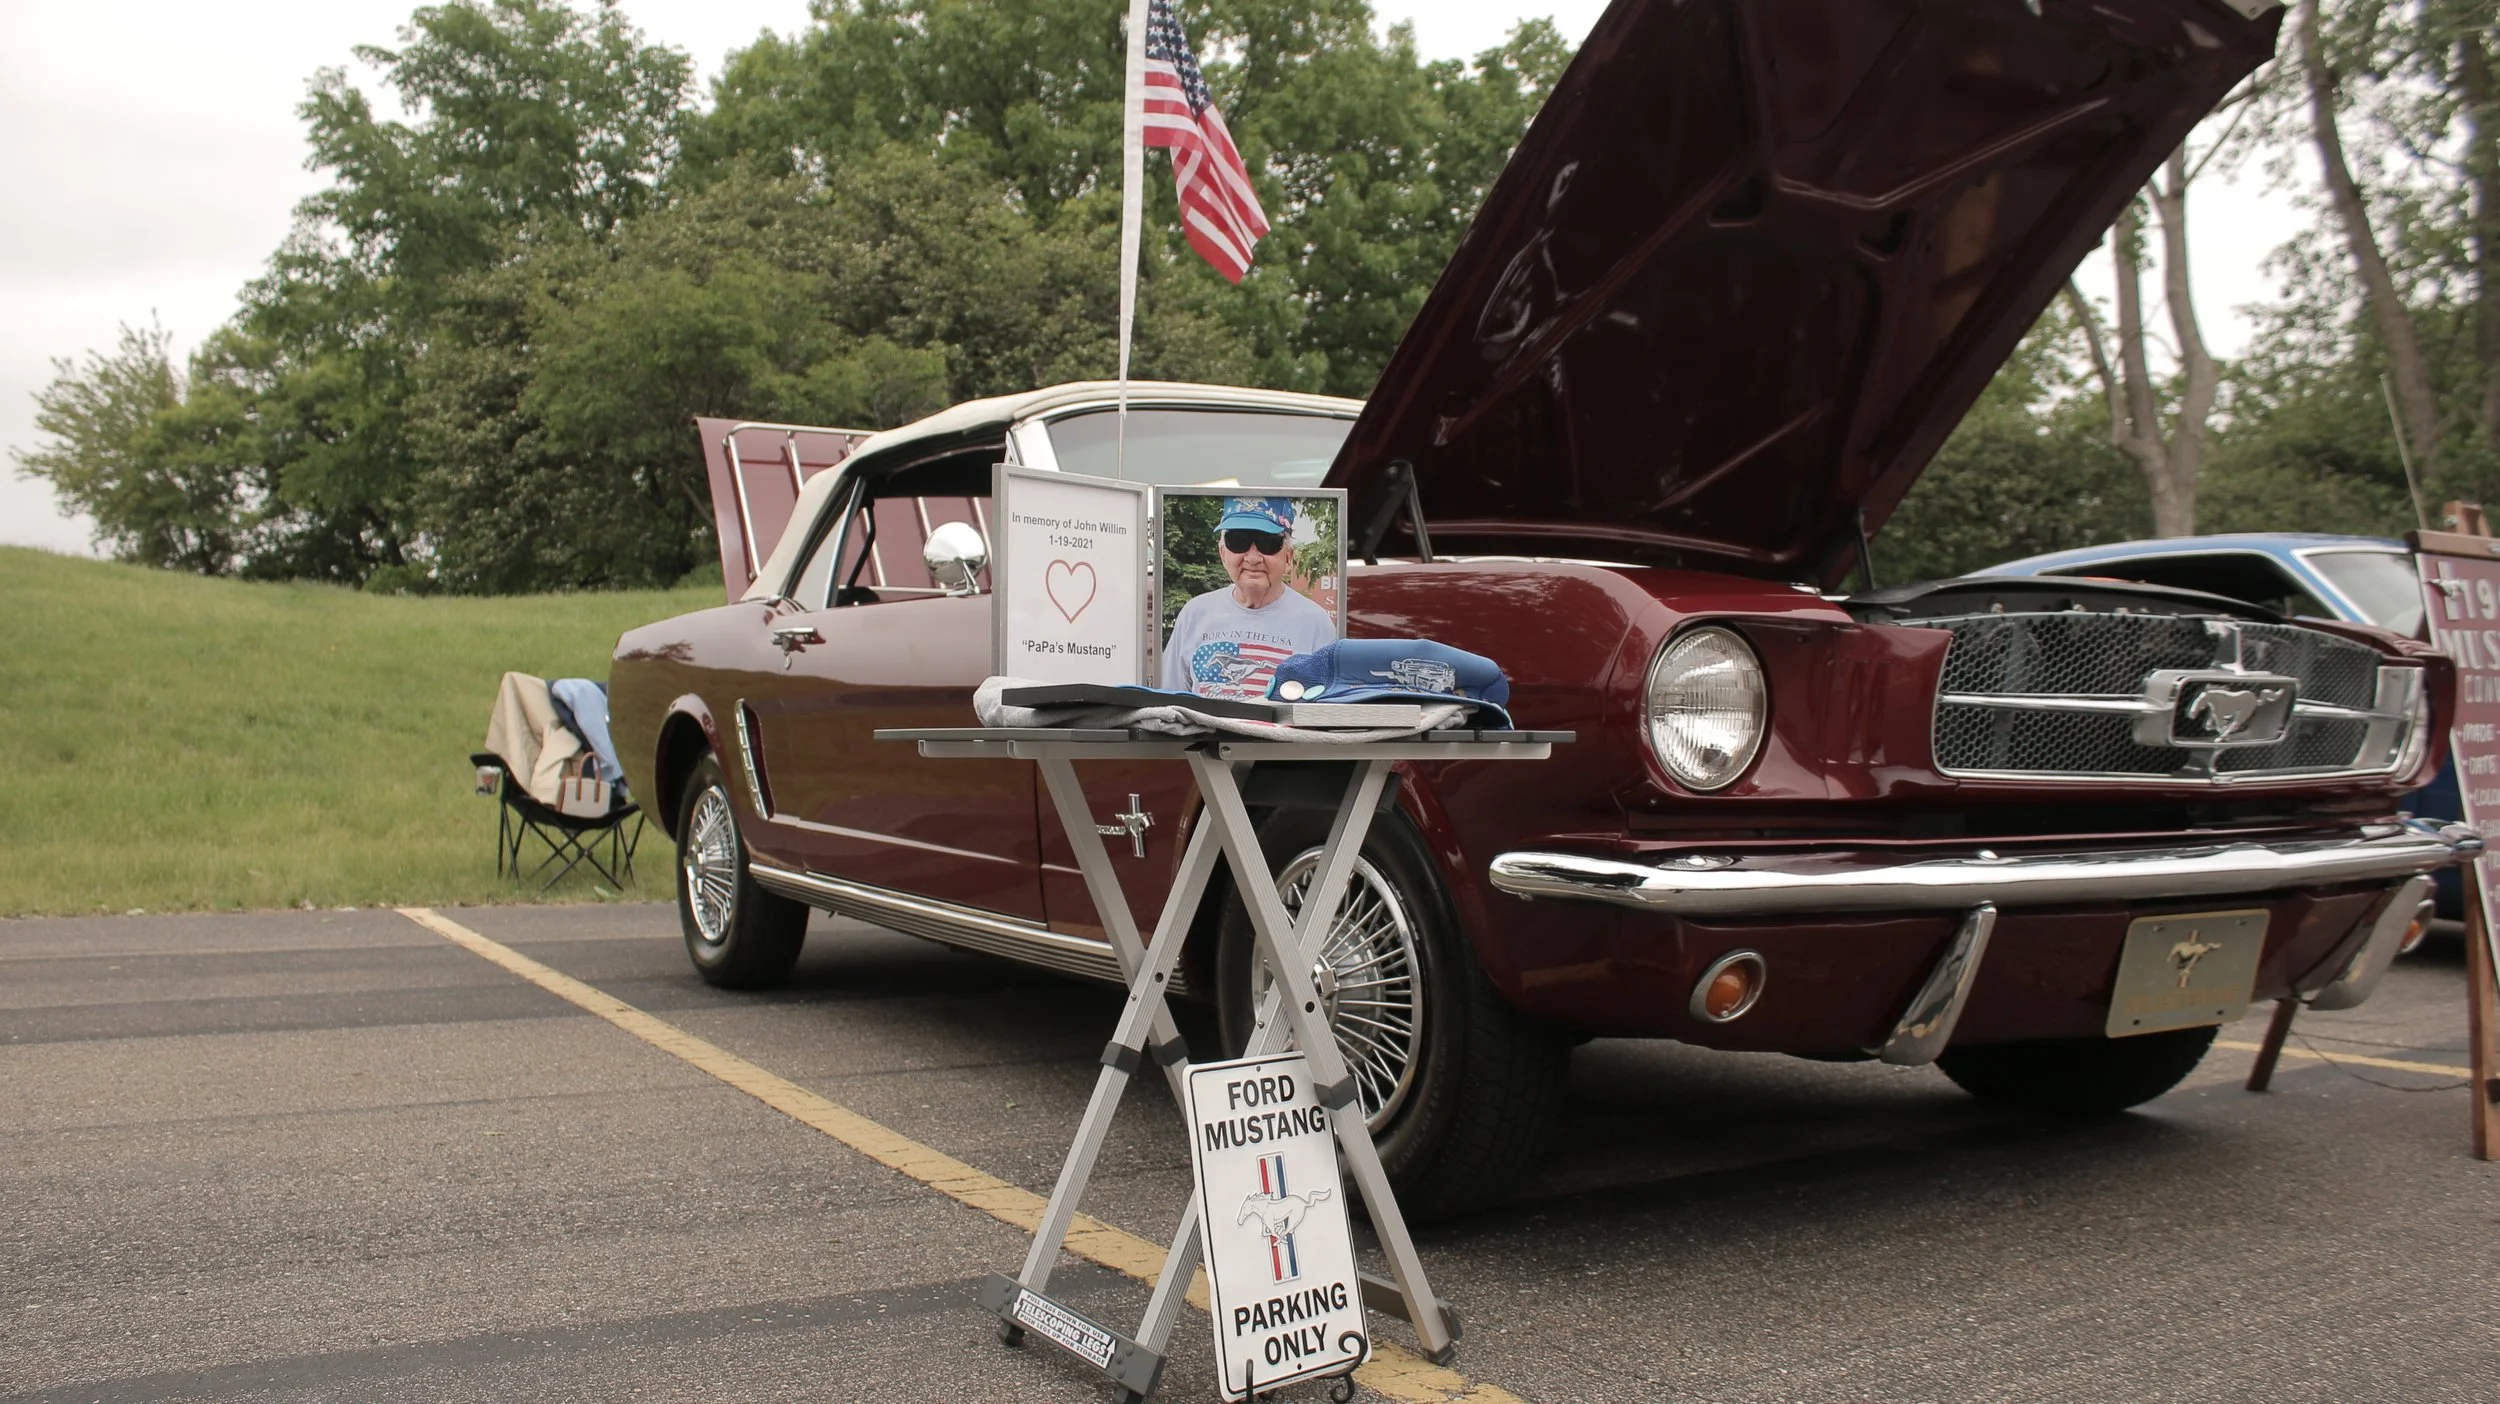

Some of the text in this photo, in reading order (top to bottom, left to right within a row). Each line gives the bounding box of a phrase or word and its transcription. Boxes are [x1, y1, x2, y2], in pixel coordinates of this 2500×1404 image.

[1012, 512, 1127, 535] In memory of John Willim
[1049, 534, 1093, 550] 1-19-2021
[1067, 642, 1117, 659] Mustang"
[1202, 630, 1292, 646] BORN IN THE USA
[1227, 1074, 1295, 1110] FORD
[1205, 1105, 1326, 1152] MUSTANG
[1020, 1300, 1107, 1355] TELESCOPING LEGS
[1026, 1294, 1104, 1340] PULL LEGS DOWN FOR USE
[1234, 1282, 1348, 1337] PARKING
[1020, 1313, 1105, 1366] PUSH LEGS UP FOR STORAGE
[1264, 1322, 1328, 1366] ONLY
